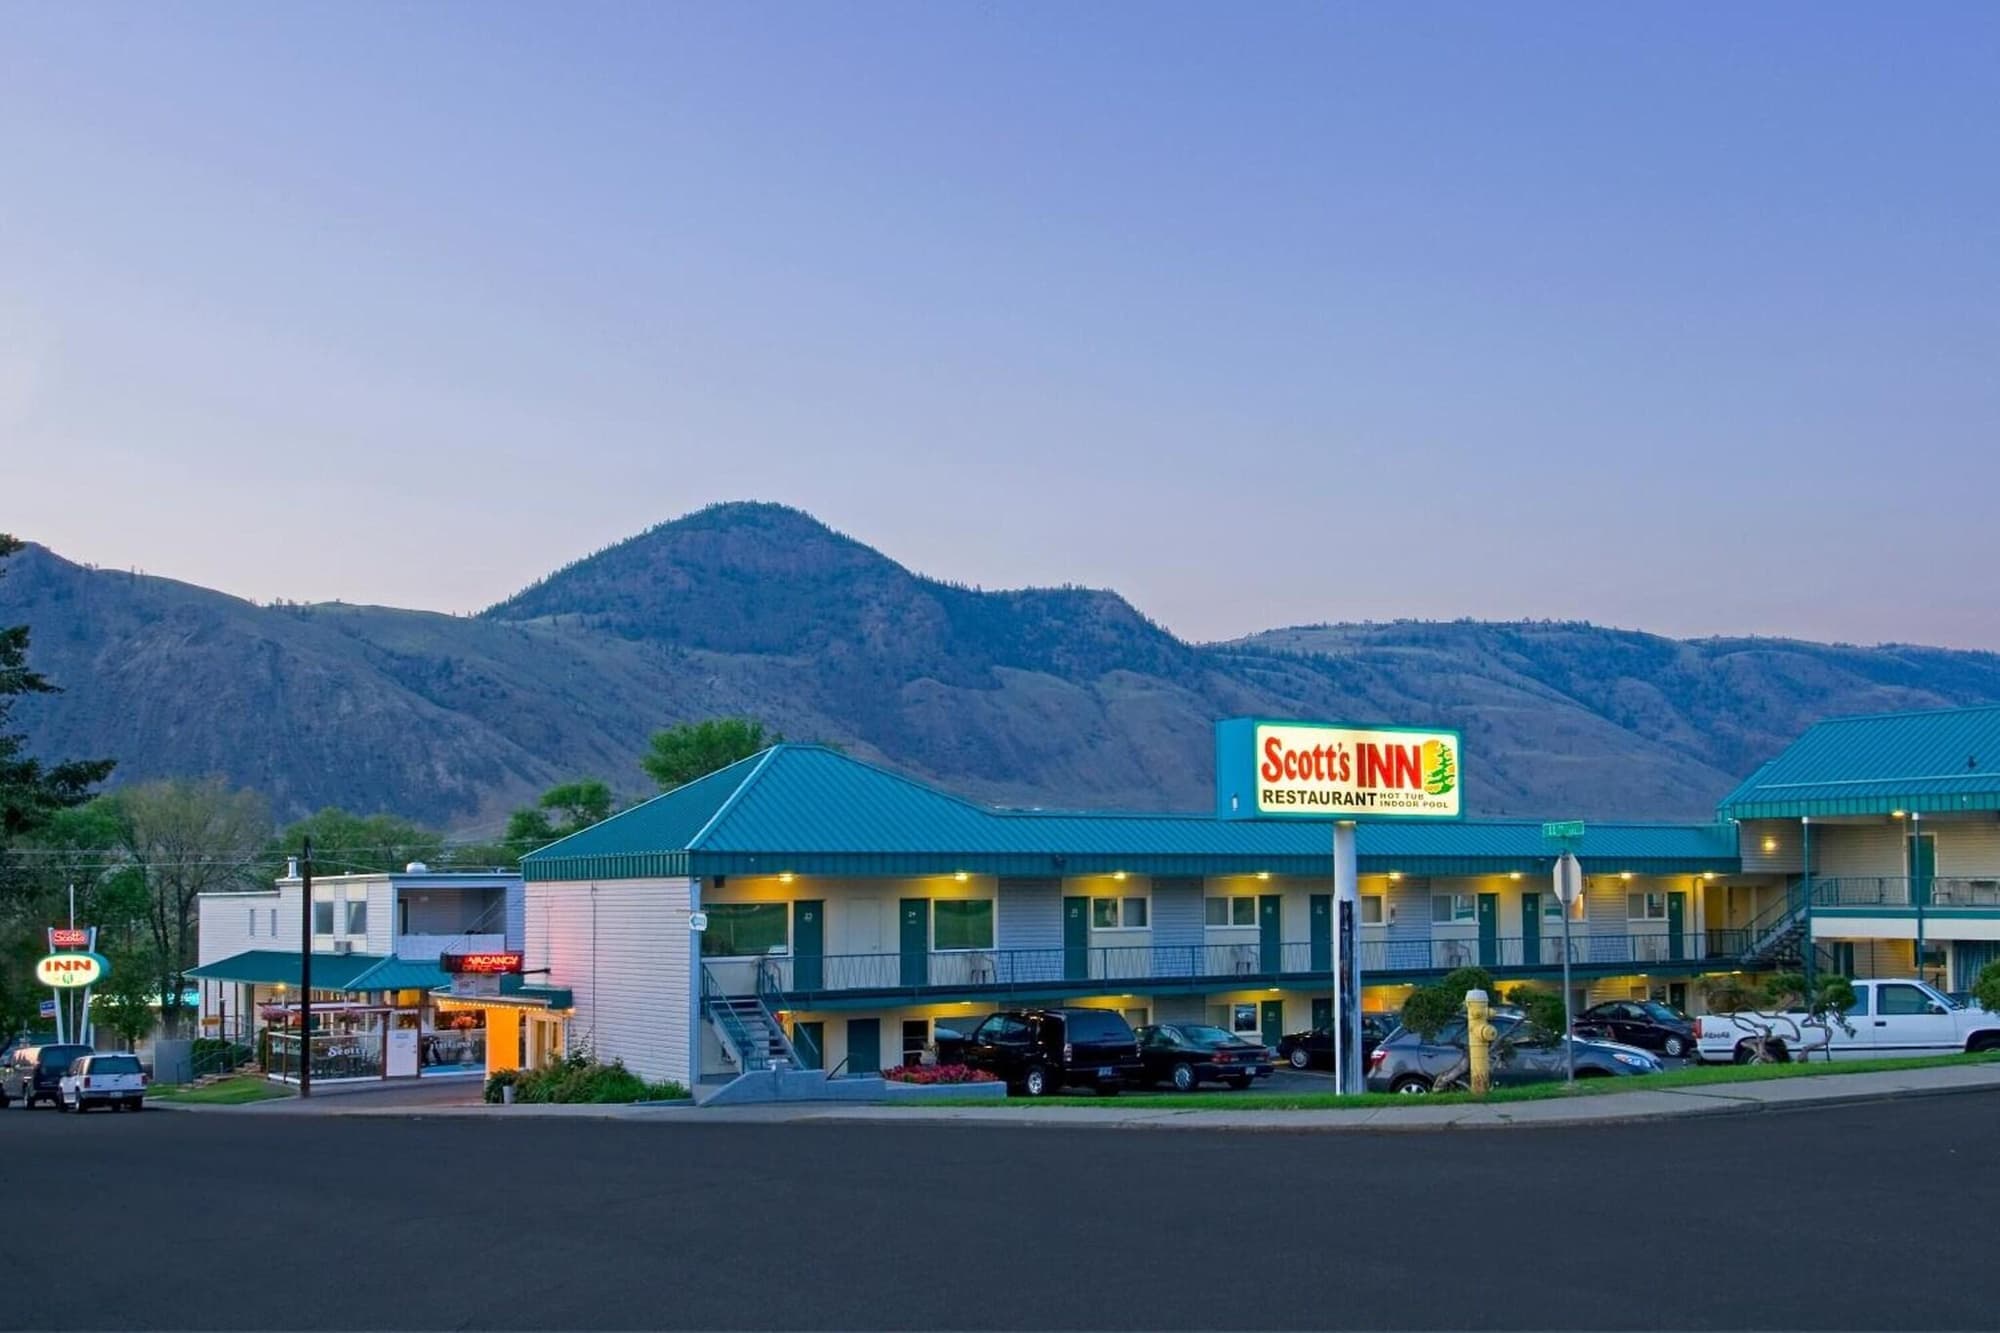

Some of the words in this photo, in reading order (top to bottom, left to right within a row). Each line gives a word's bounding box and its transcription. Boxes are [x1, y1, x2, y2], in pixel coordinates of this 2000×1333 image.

[1261, 736, 1350, 783] Scott's
[1356, 743, 1422, 789] INN
[1262, 789, 1377, 806] RESTAURANT
[1405, 792, 1424, 800] TUB
[1379, 800, 1420, 808] INDOOR
[468, 955, 519, 965] VACANCY
[45, 960, 91, 971] INN
